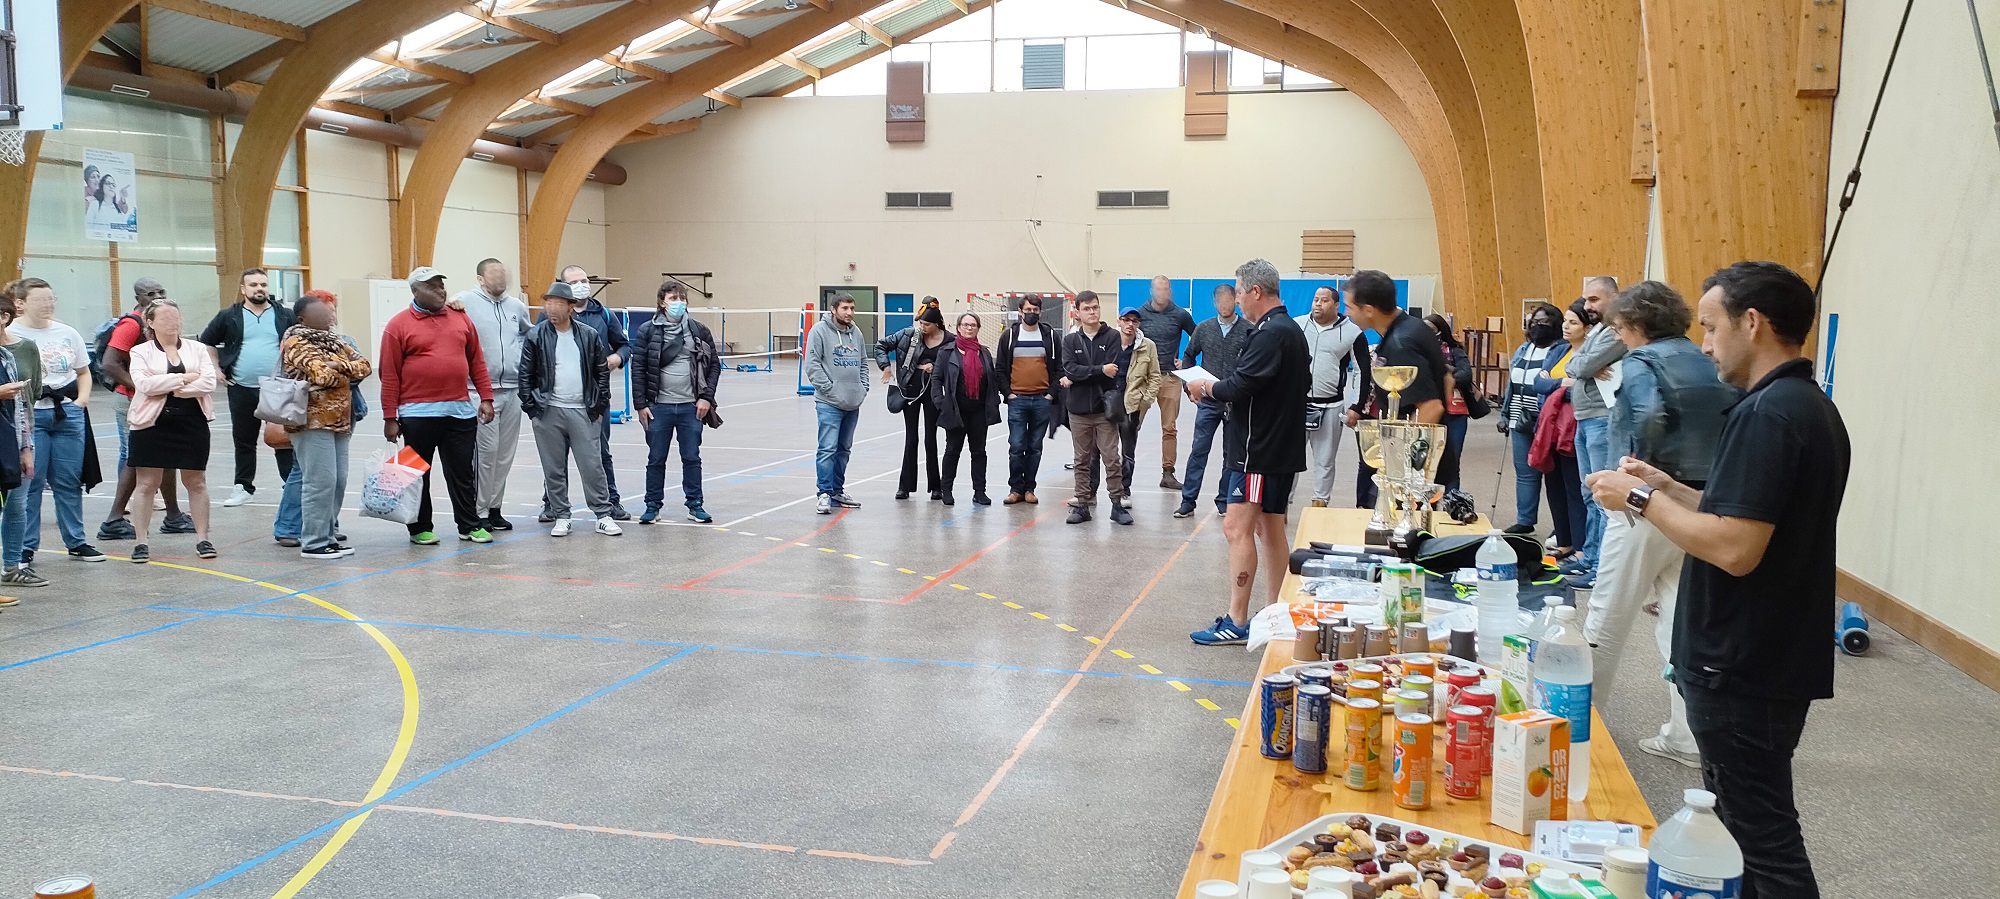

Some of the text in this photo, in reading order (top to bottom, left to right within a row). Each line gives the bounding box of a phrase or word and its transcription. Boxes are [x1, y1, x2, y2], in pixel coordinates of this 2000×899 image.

[372, 487, 396, 497] ACTION
[1505, 657, 1525, 674] JUS
[1273, 704, 1293, 754] ORANGINA
[1552, 748, 1566, 766] OR
[1553, 766, 1566, 783] AN
[1553, 782, 1566, 800] GE
